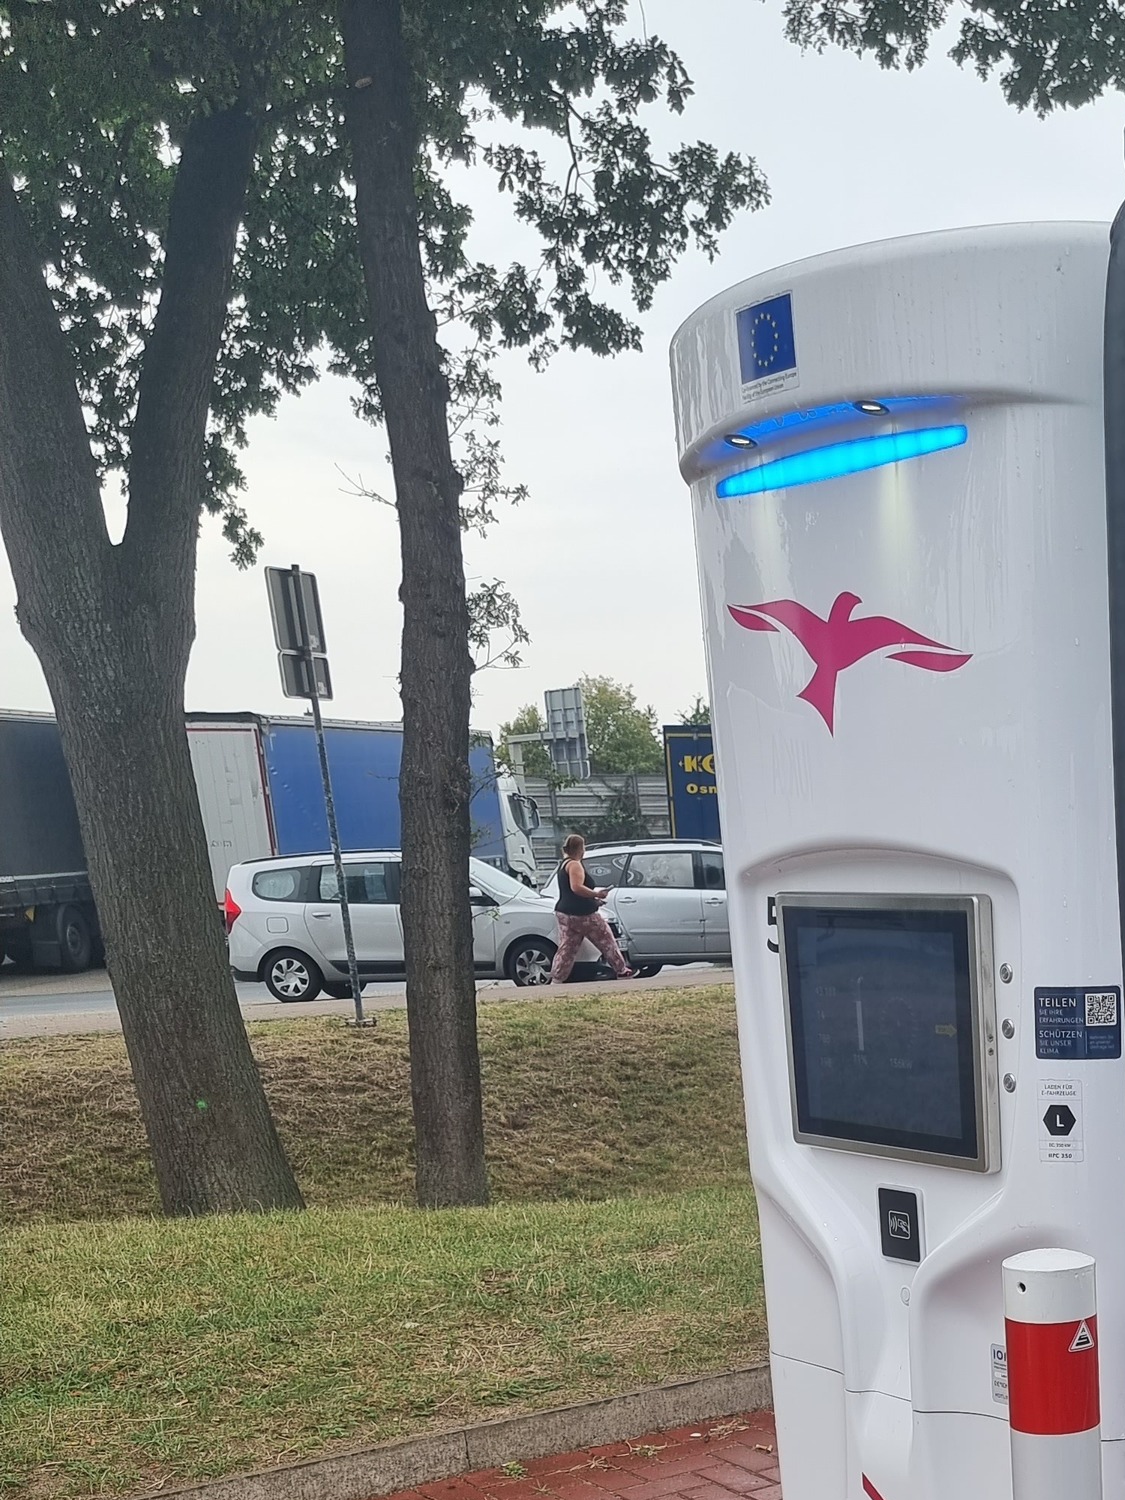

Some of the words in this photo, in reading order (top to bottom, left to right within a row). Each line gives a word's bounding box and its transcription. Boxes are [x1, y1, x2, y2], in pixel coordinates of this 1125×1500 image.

[1039, 997, 1076, 1007] TEILEN
[1039, 1029, 1083, 1038] SCHÜTZEN
[1056, 1114, 1065, 1127] L
